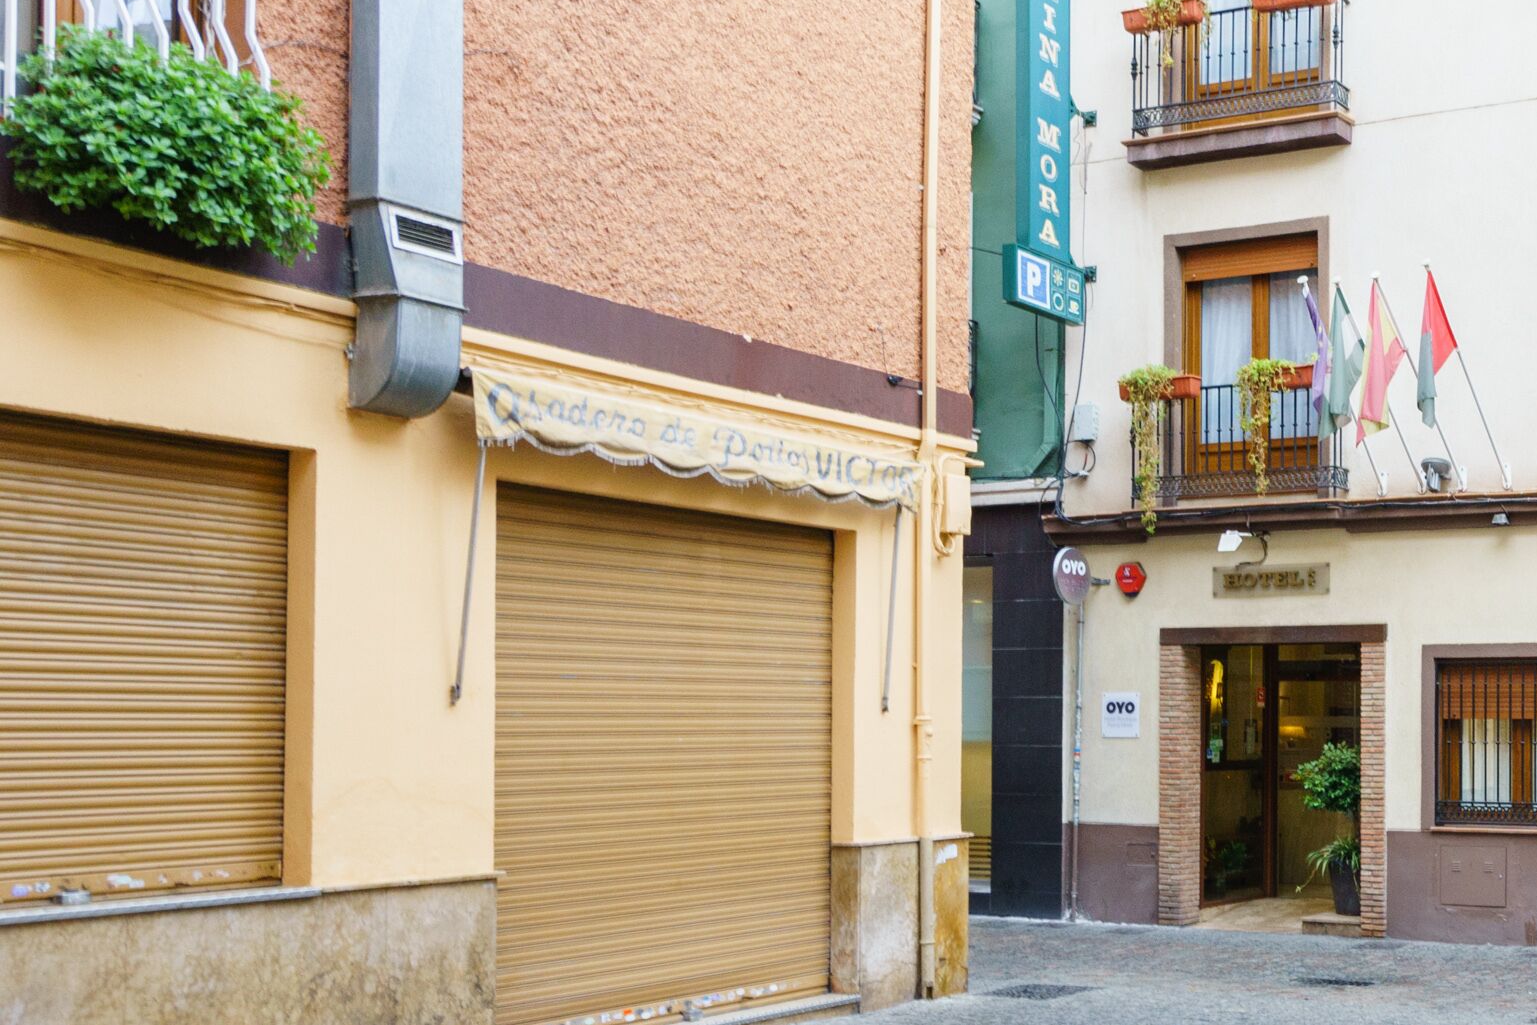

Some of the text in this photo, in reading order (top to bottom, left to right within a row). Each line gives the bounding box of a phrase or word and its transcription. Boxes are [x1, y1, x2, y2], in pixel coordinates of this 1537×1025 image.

[1037, 117, 1061, 249] MORA
[1026, 262, 1042, 298] P
[659, 418, 698, 449] de
[814, 449, 915, 501] VICTOR
[1061, 558, 1087, 577] OYO
[1222, 570, 1305, 589] HOTEL
[1106, 701, 1136, 715] OYO
